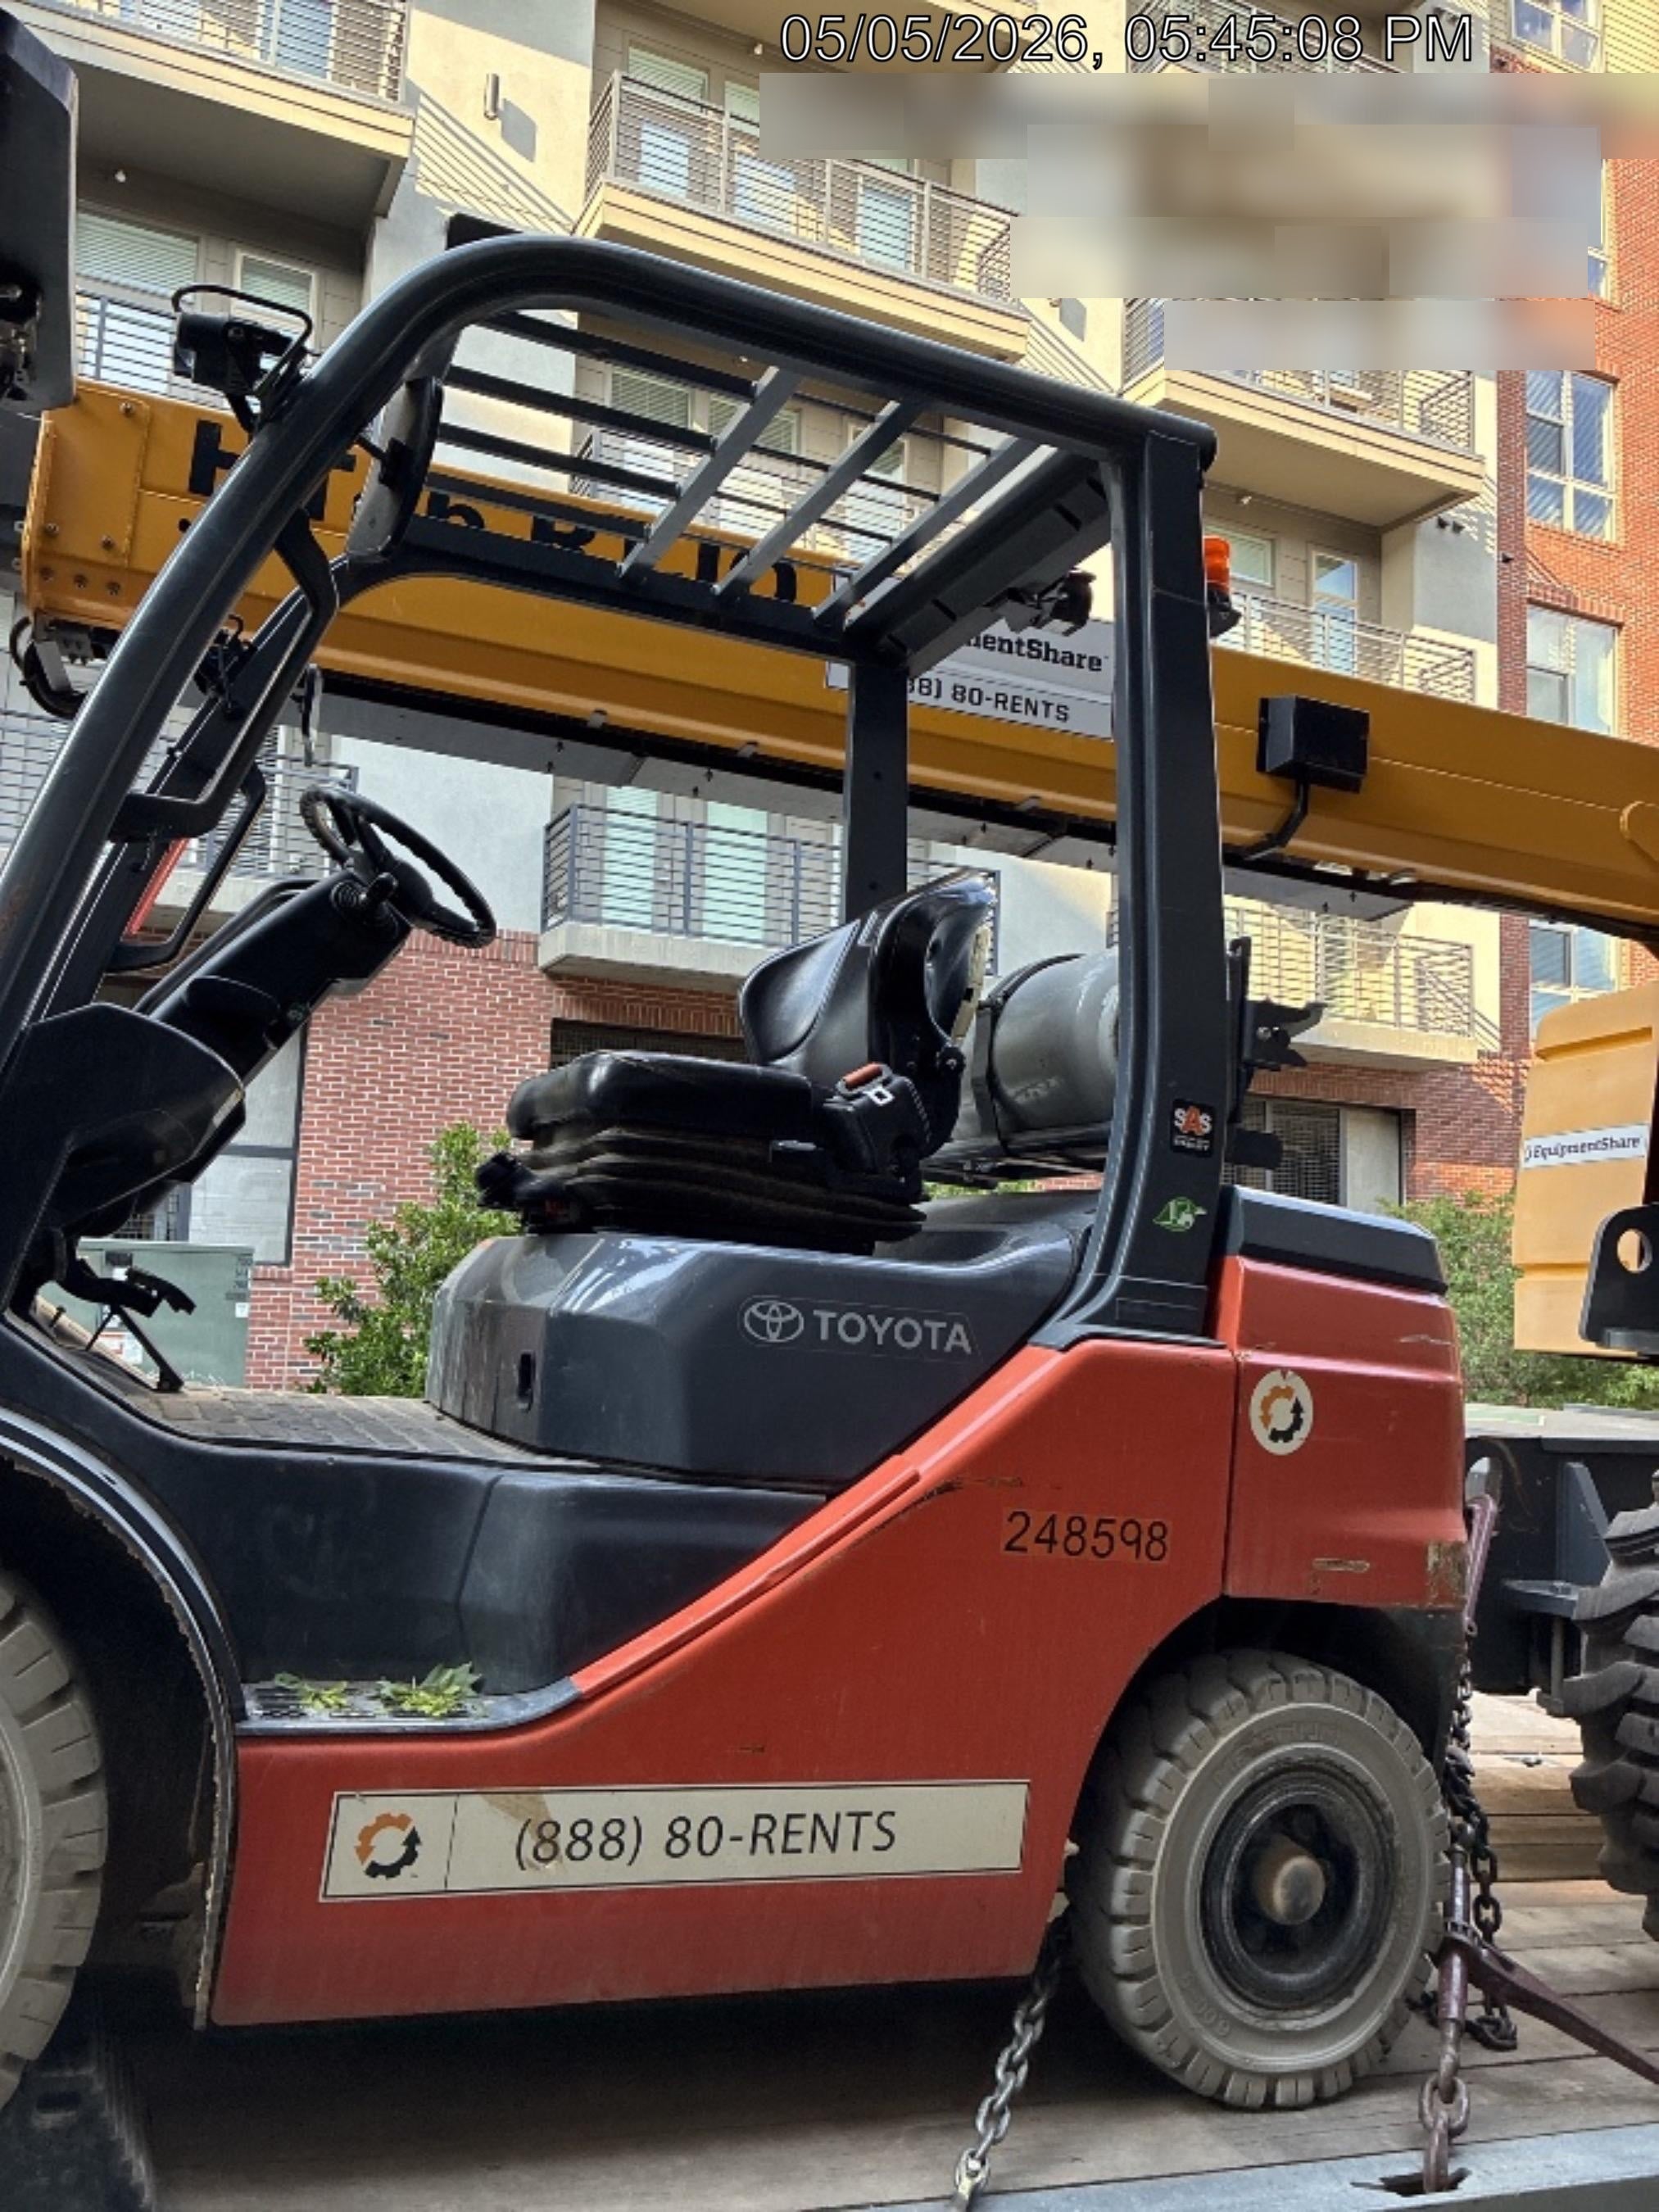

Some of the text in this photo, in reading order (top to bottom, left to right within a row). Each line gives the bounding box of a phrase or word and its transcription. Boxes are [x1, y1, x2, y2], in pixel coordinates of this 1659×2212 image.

[951, 683, 1070, 723] 80-RENTS
[1174, 1106, 1213, 1136] SAS
[1533, 1136, 1641, 1160] EquipmentShare
[813, 1309, 972, 1355] TOYOTA
[1004, 1511, 1168, 1562] 248598
[515, 1810, 897, 1871] (888) 80-RENTS
